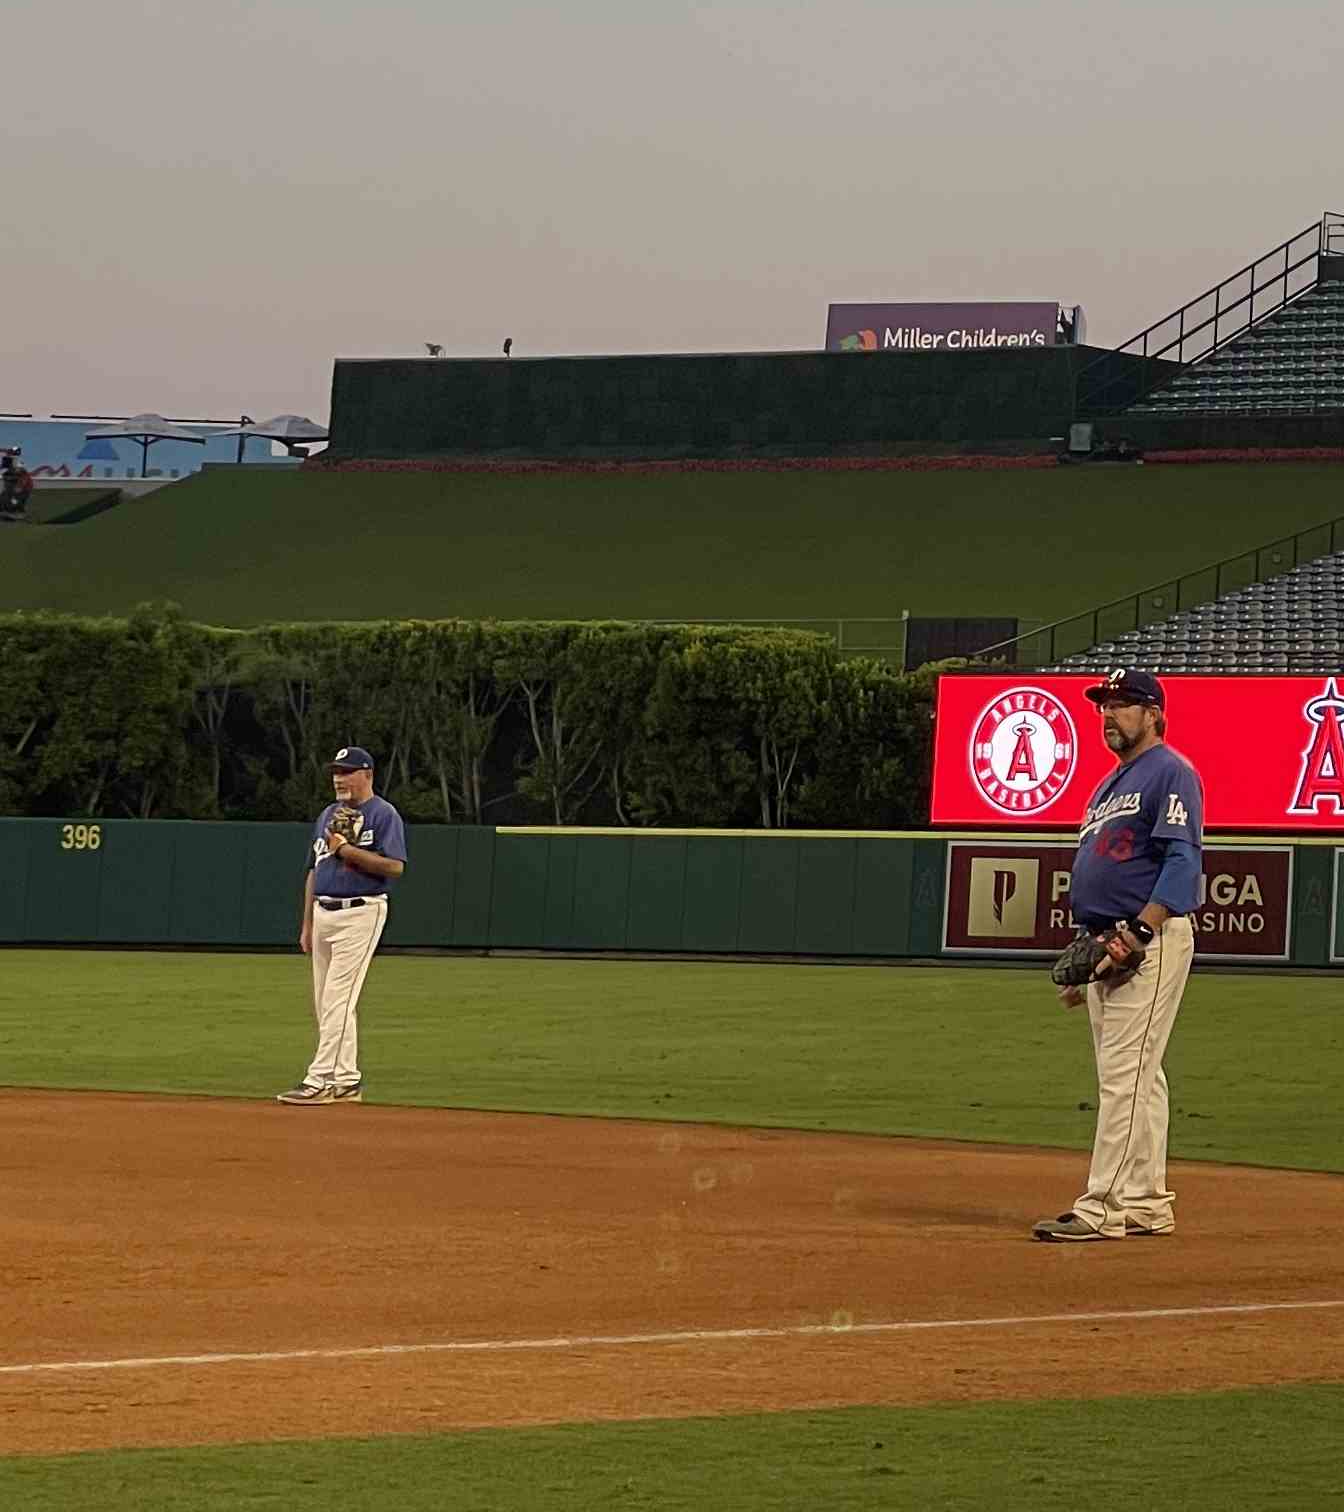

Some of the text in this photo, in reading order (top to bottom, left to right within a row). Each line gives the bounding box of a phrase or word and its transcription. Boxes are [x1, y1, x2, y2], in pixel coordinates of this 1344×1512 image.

[884, 327, 1045, 349] Miller Children's
[991, 694, 1061, 723] ANGELS
[979, 768, 1065, 808] BASEBALL
[1165, 792, 1189, 827] LA
[61, 823, 101, 850] 396
[1187, 912, 1266, 933] ASINO
